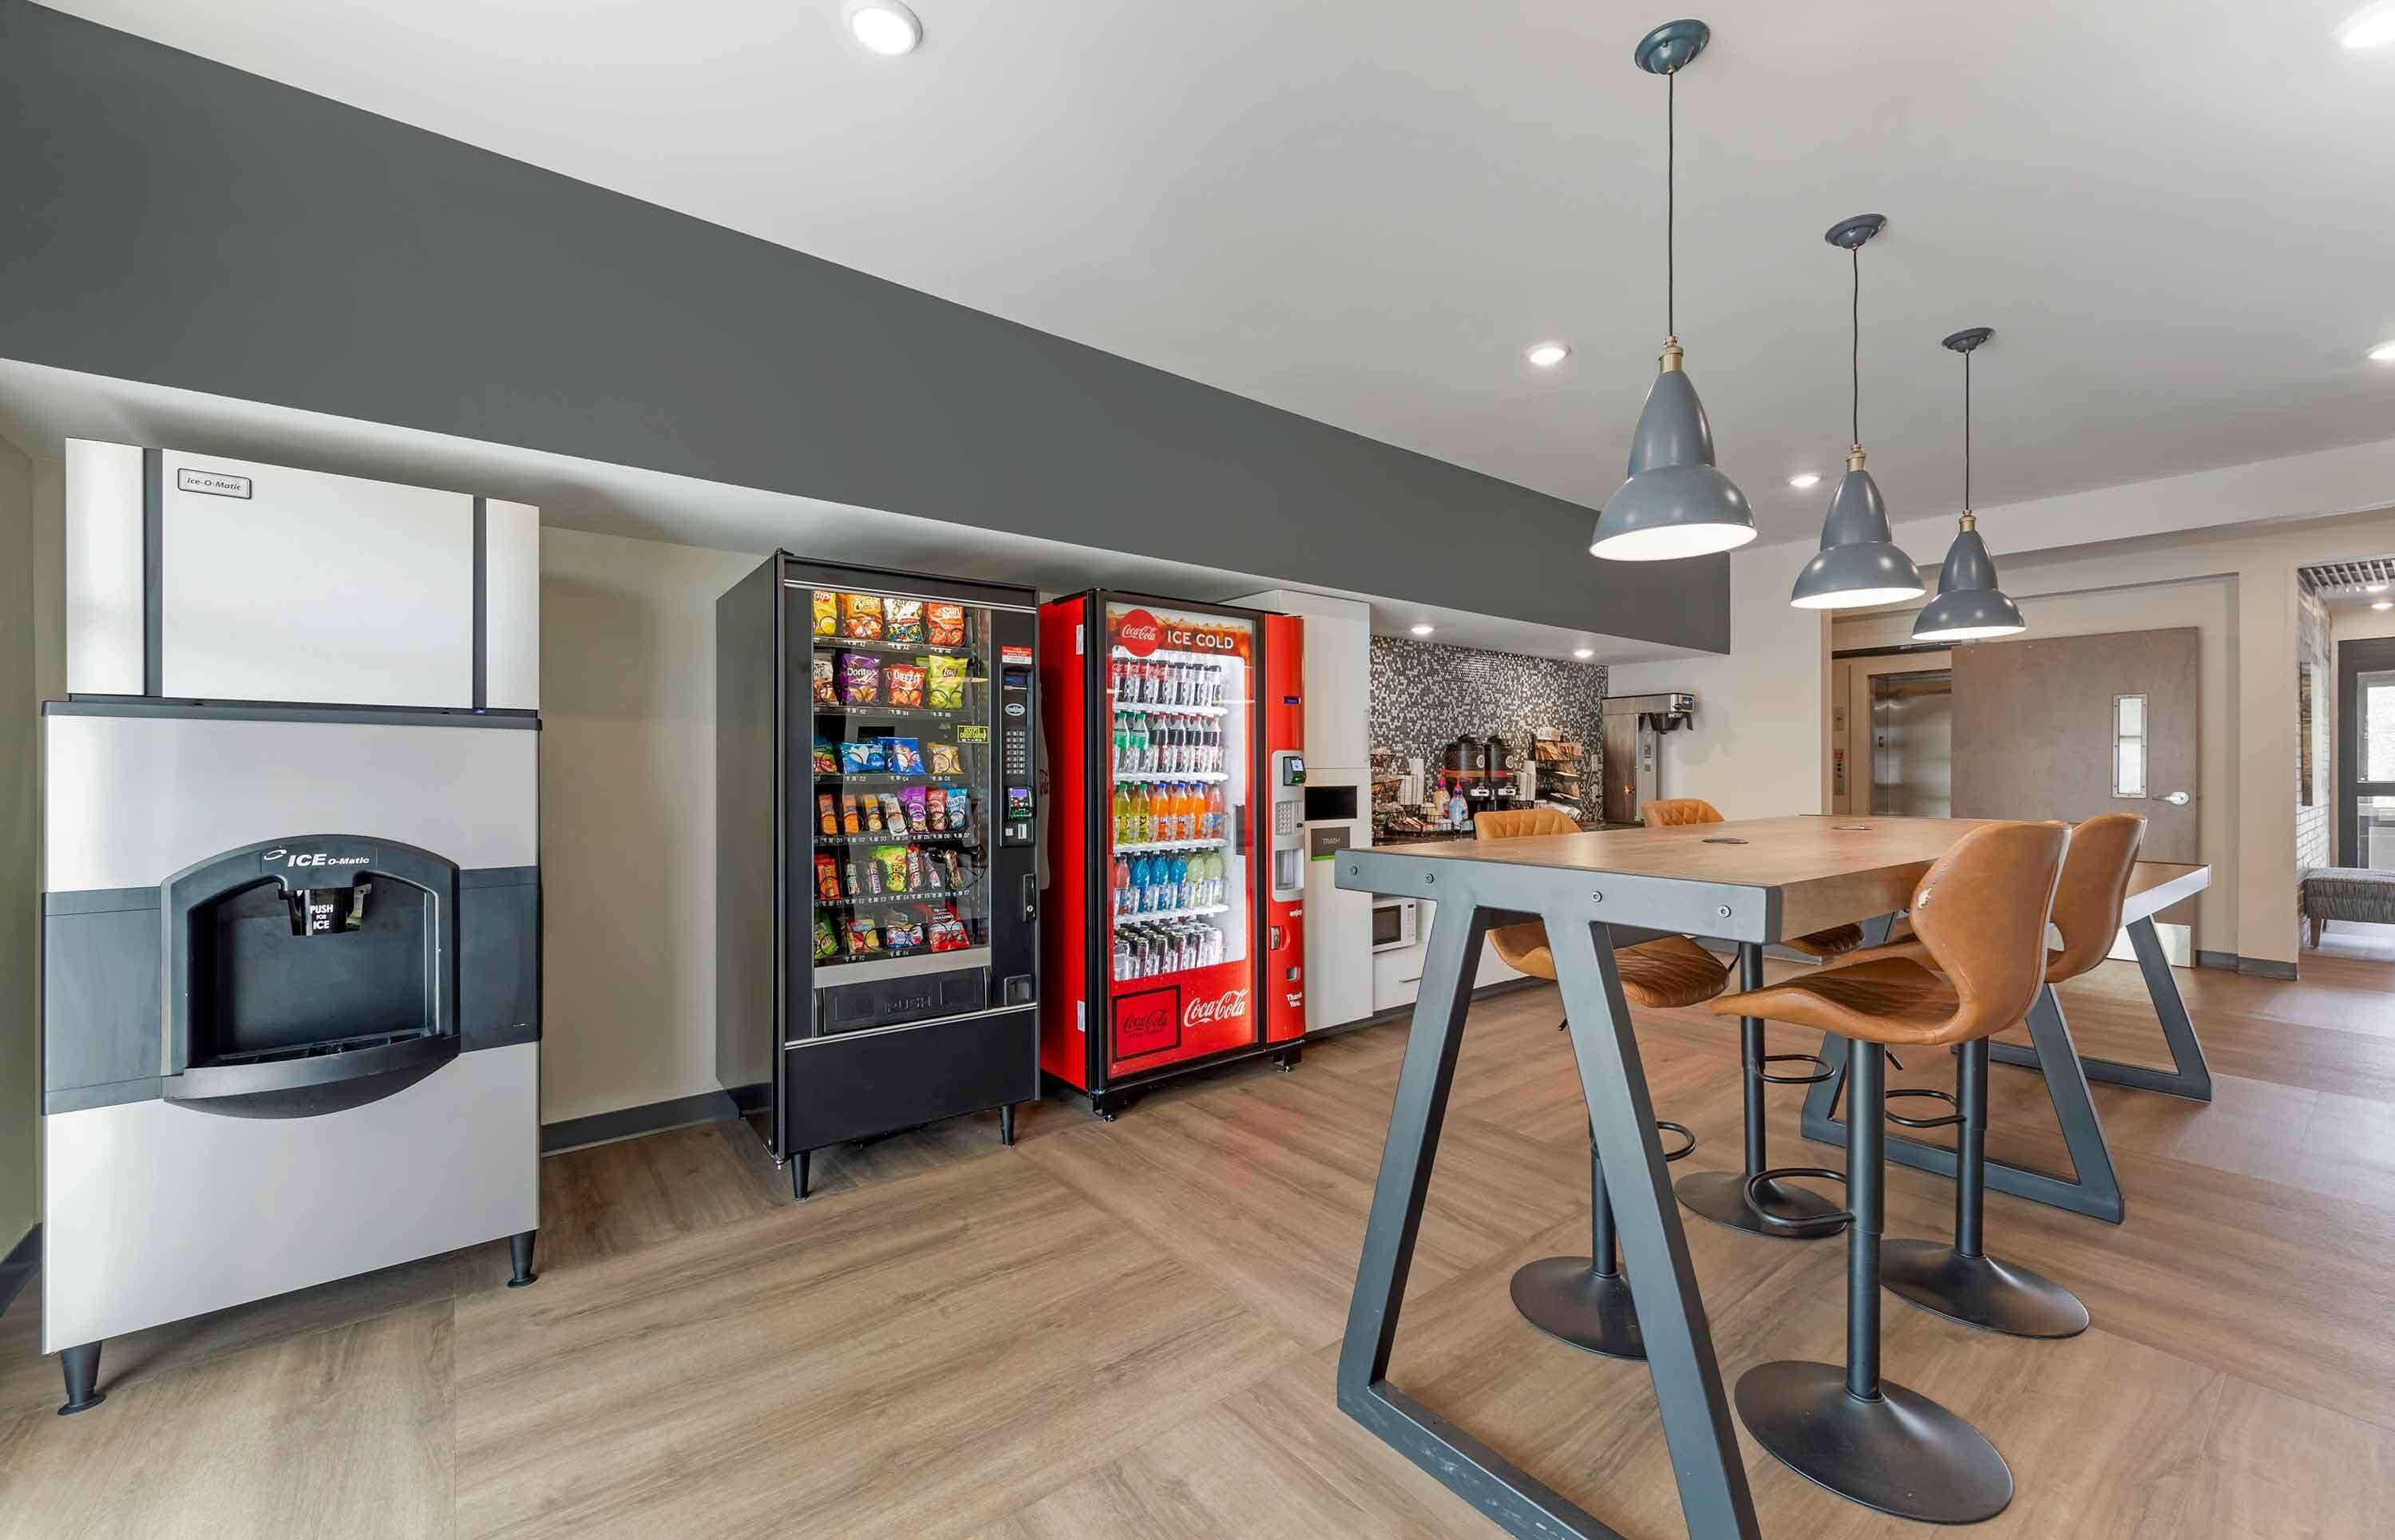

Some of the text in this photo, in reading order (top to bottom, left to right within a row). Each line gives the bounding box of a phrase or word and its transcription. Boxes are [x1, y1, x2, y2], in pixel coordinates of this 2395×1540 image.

[187, 477, 241, 491] Ice-O-Matic
[1122, 624, 1158, 641] Coca-Cola
[1167, 630, 1234, 650] ICE COLD
[287, 853, 327, 868] ICE
[310, 905, 334, 914] PUSH
[1289, 909, 1303, 918] enjoy
[313, 920, 330, 930] ICE
[1286, 992, 1303, 1002] Thank
[1183, 988, 1249, 1027] Coca-Cola
